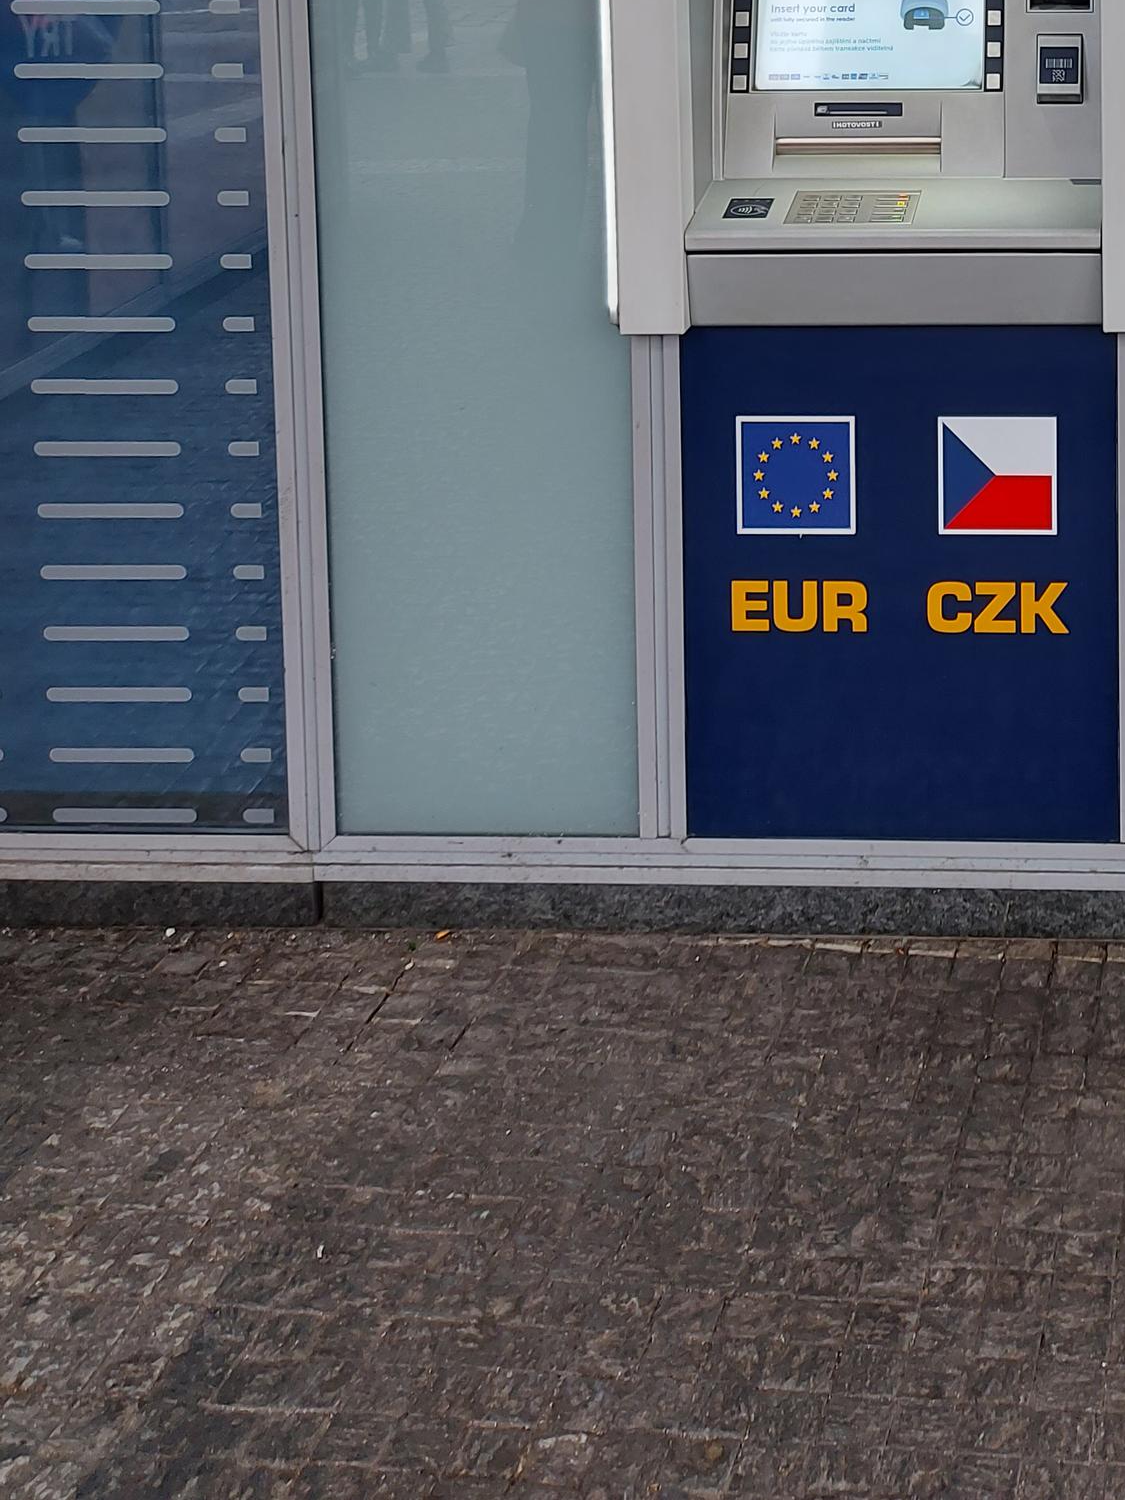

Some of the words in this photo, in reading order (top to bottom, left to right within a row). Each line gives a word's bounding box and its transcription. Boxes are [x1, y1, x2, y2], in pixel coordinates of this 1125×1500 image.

[771, 4, 800, 13] Insert
[803, 5, 827, 15] your
[830, 3, 855, 13] card
[731, 579, 869, 632] EUR
[926, 580, 1070, 634] CZK
